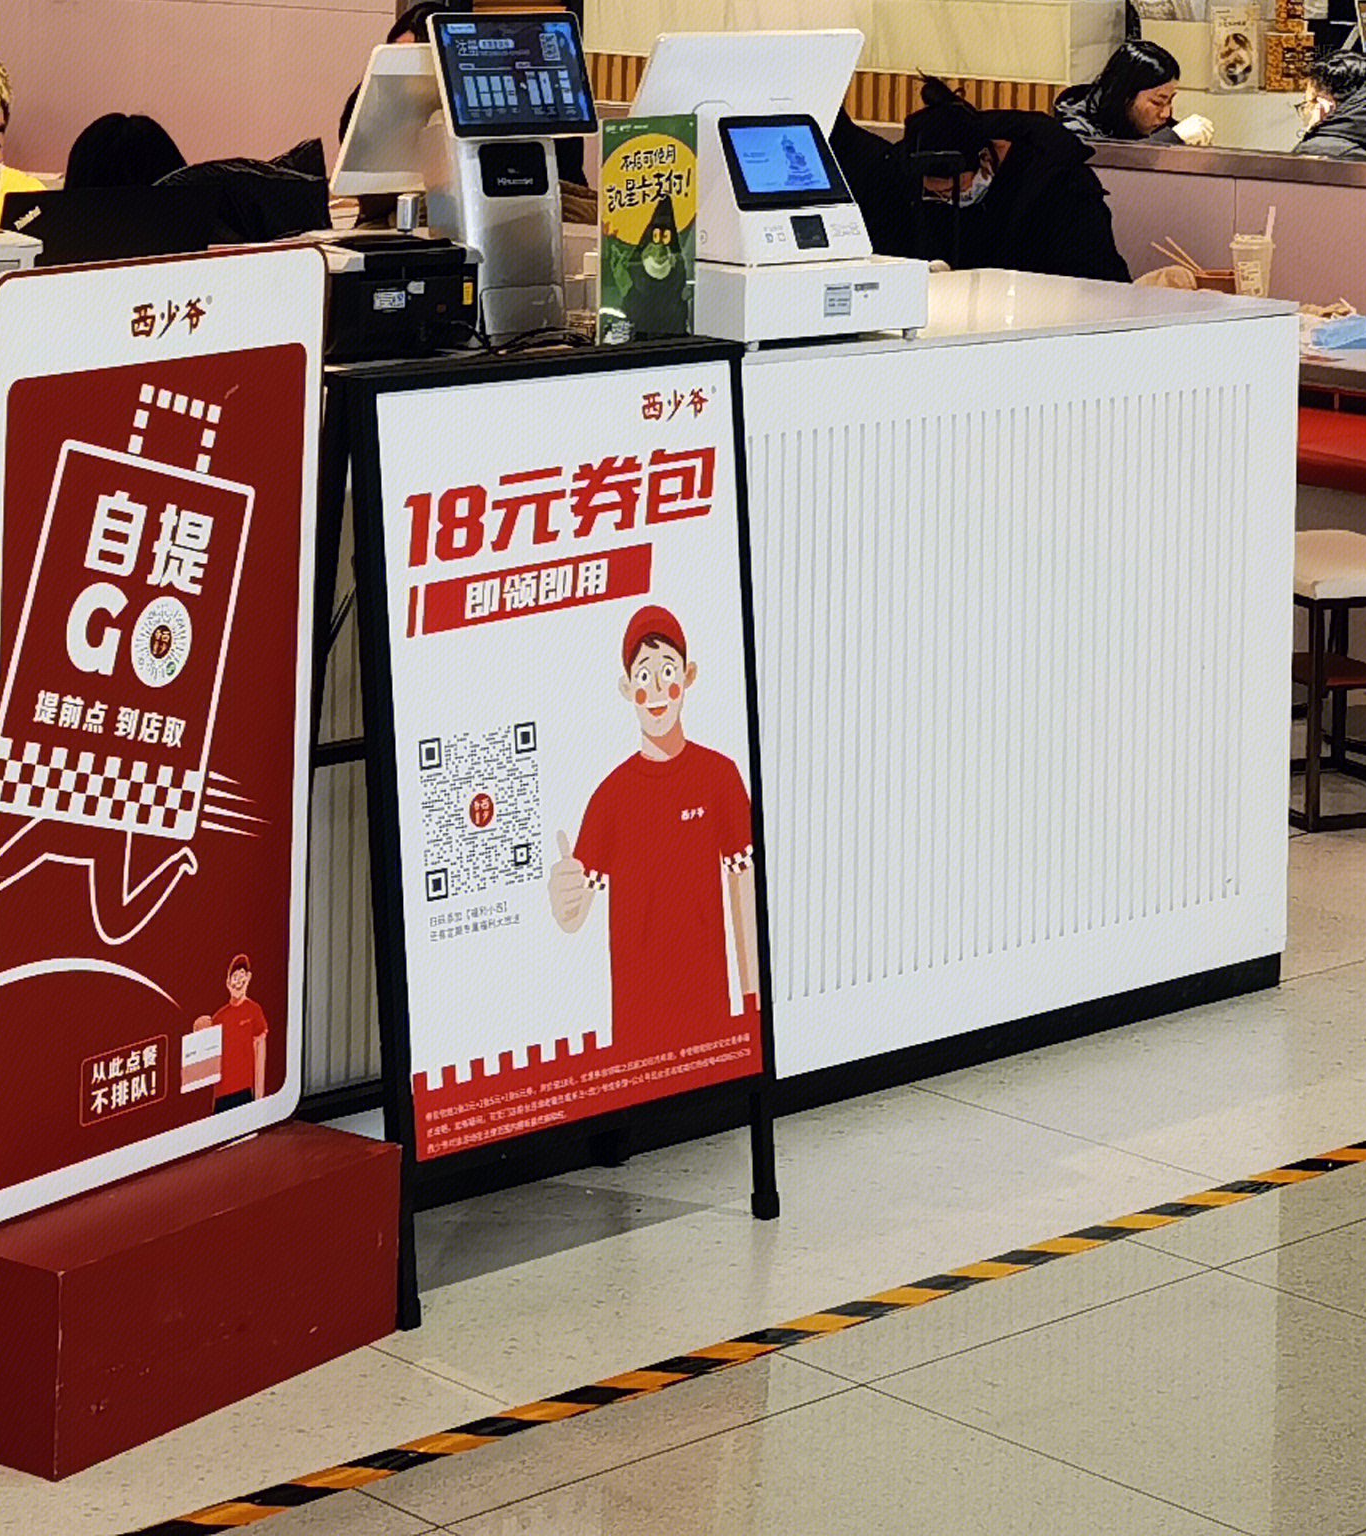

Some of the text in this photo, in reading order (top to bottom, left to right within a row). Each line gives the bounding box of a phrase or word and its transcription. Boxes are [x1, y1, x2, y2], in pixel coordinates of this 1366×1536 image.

[130, 297, 207, 339] 西少爷
[641, 387, 710, 422] 西少爷
[403, 445, 717, 569] 18元券包
[83, 490, 215, 596] 自提
[464, 557, 610, 620] 即领即用
[32, 689, 187, 749] 提前点 到店取
[90, 1044, 158, 1085] 从此点餐
